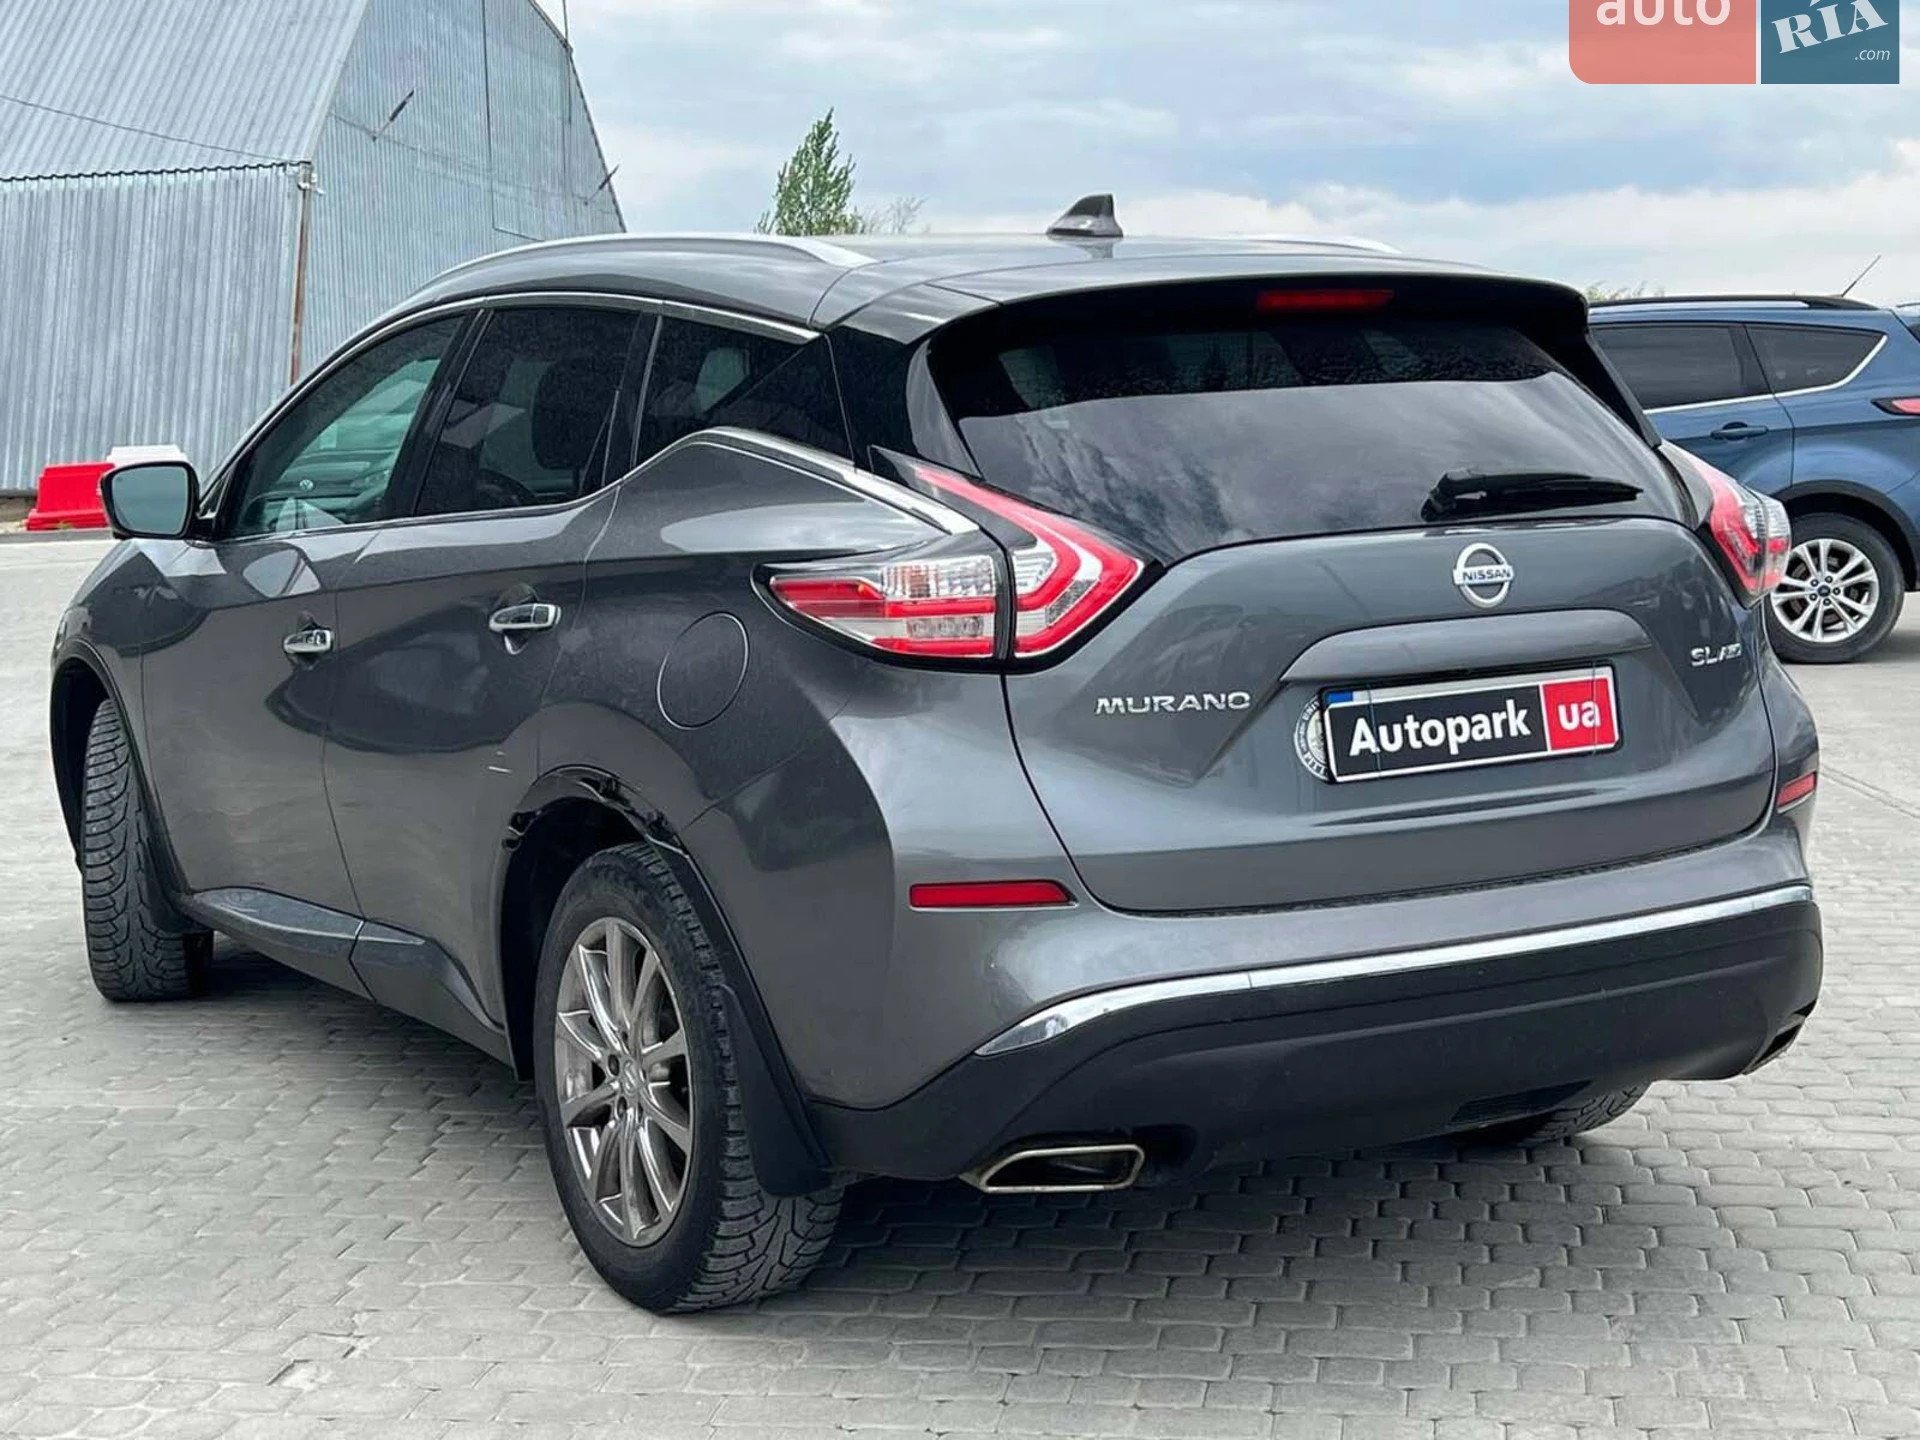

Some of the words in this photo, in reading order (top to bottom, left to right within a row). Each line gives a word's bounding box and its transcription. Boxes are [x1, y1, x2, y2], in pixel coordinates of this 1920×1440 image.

[1463, 567, 1511, 581] NISSAN
[1096, 691, 1251, 714] MURANO
[1349, 699, 1531, 755] Autopark
[1557, 700, 1602, 731] ua
